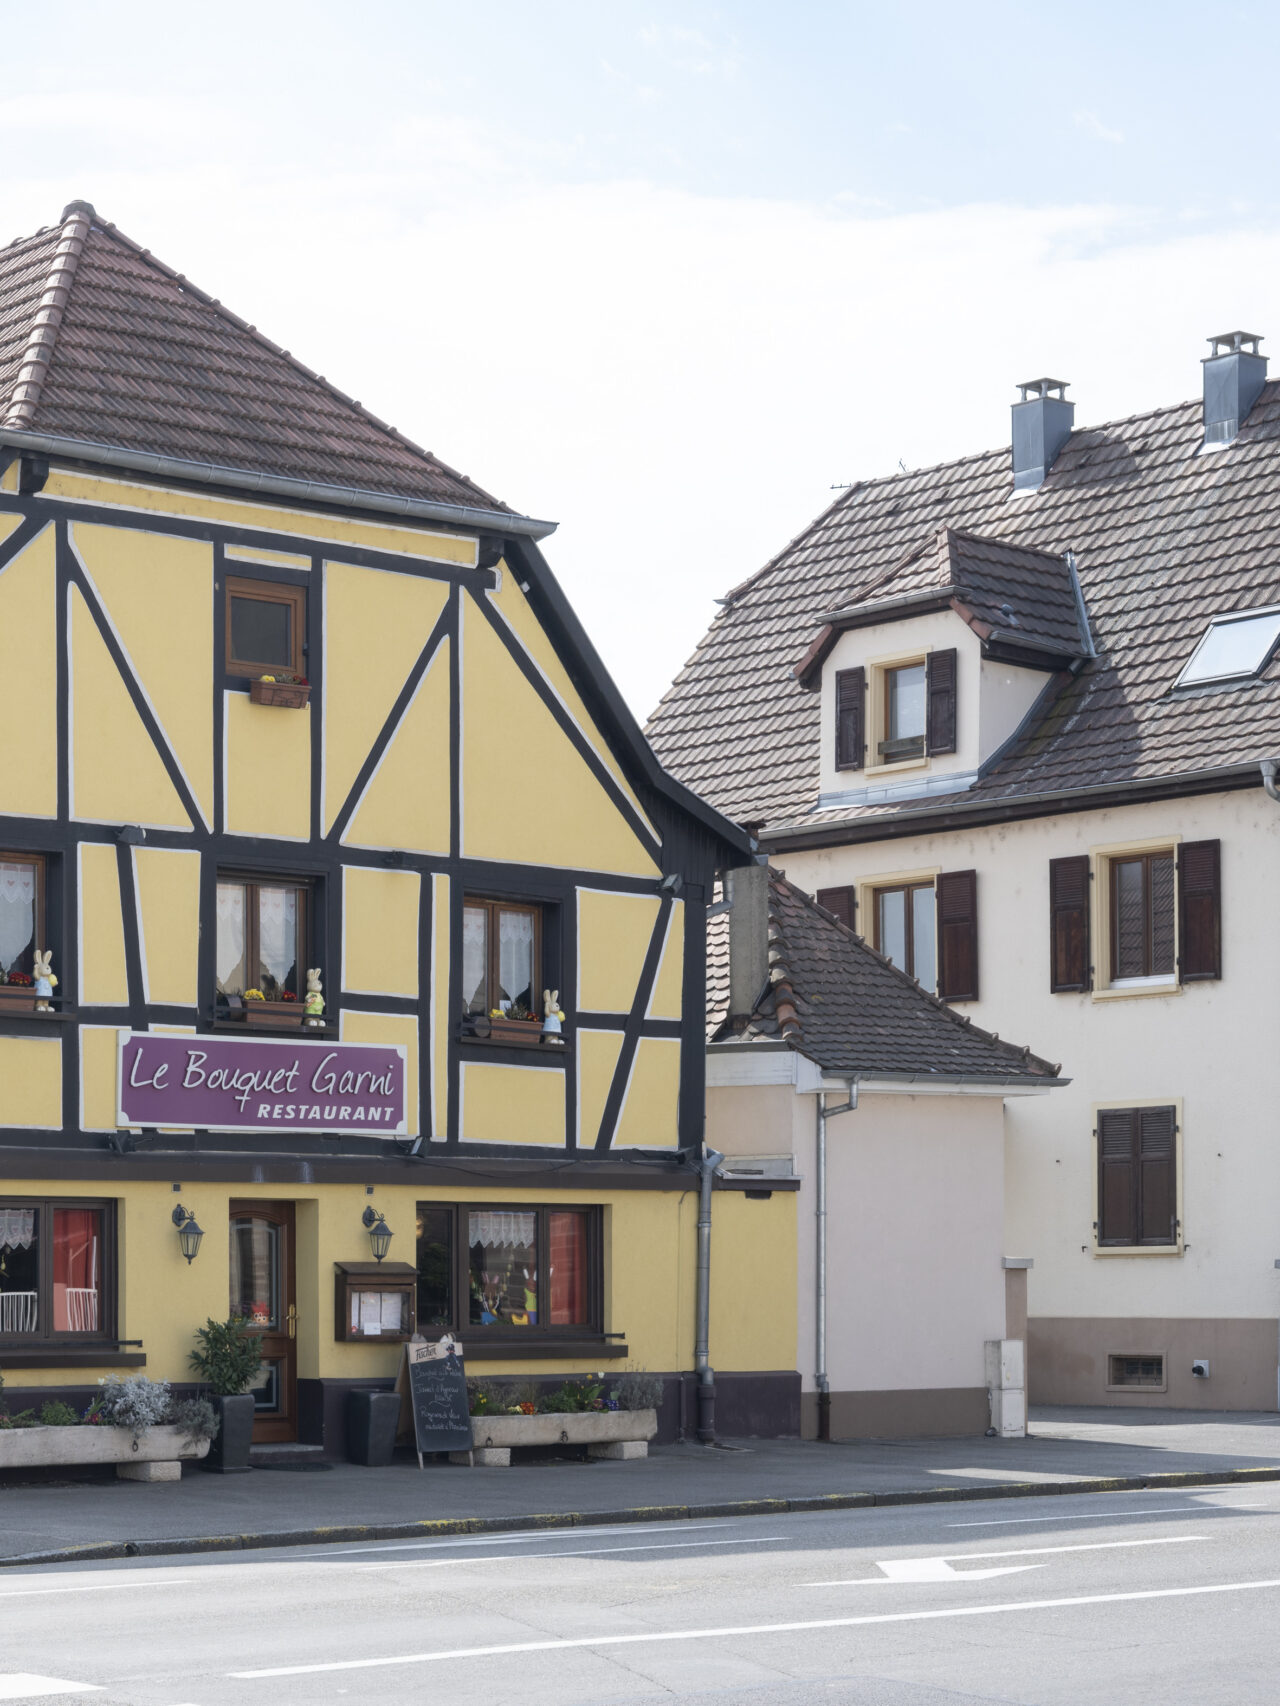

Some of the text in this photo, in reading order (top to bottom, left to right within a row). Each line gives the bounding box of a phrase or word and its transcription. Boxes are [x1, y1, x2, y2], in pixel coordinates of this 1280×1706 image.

[130, 1047, 395, 1113] Le Bouquet Garni
[257, 1103, 395, 1122] RESTAURANT
